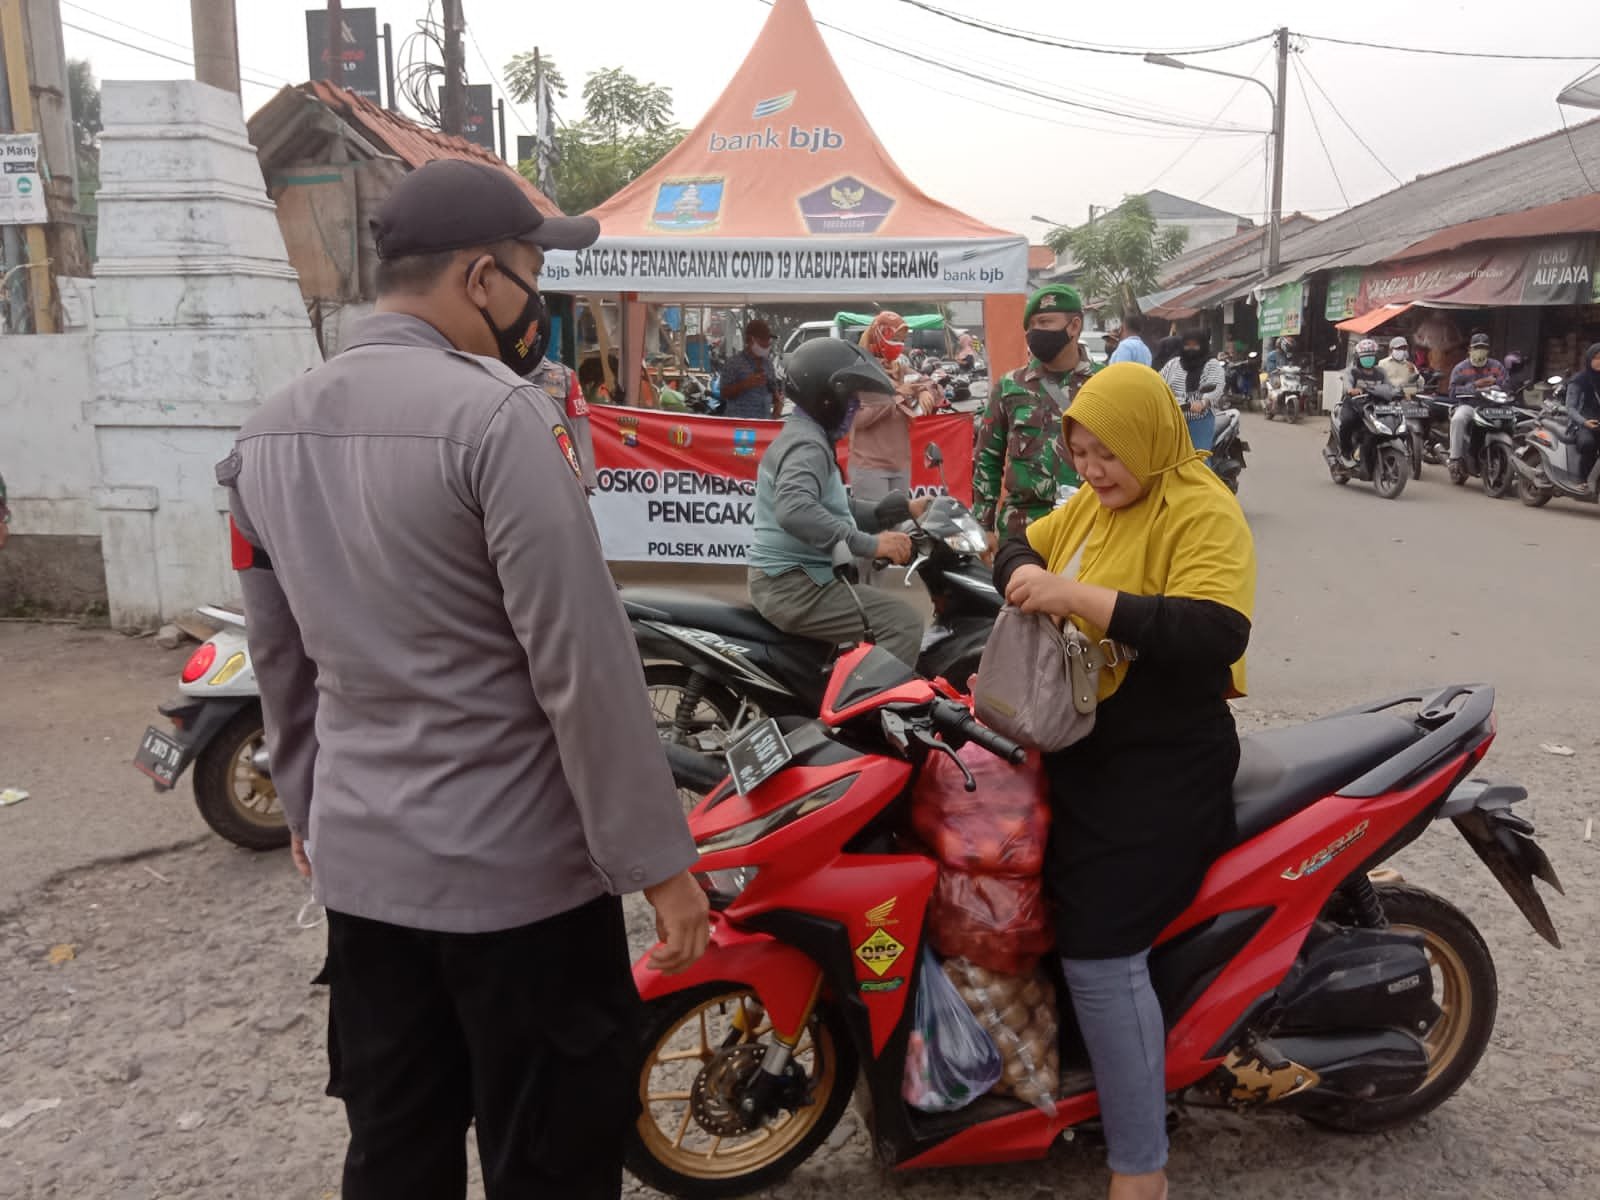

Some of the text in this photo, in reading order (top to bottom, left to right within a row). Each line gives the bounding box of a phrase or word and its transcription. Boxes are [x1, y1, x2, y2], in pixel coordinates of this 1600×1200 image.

[709, 126, 843, 153] bank bjb
[546, 265, 570, 281] bjb
[574, 249, 939, 280] SATGAS PENANGANAN COVID 19 KABUPATEN SERANG
[942, 267, 1004, 283] bank bjb
[1532, 265, 1589, 285] ALIF JAYA
[597, 469, 758, 497] OSKO PEMBAG
[648, 542, 704, 557] POLSEK
